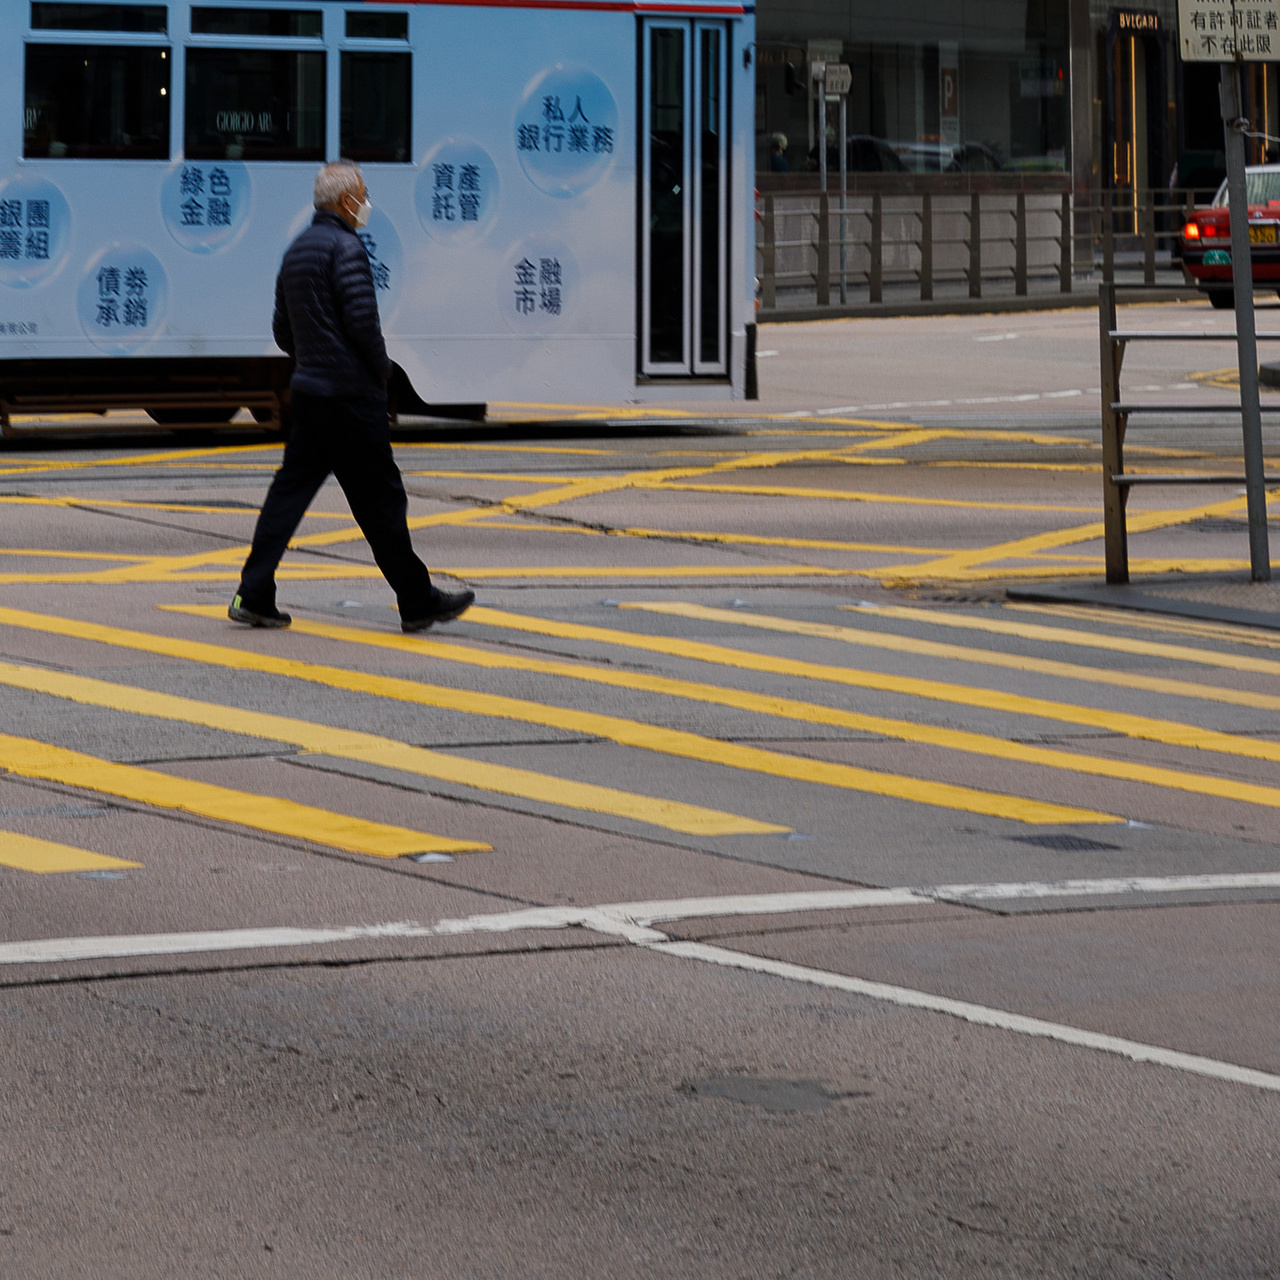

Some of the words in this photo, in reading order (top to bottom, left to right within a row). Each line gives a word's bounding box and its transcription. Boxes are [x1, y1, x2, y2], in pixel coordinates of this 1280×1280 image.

[1120, 13, 1158, 30] BVLGARI
[1190, 10, 1278, 30] 有許可証者
[1200, 34, 1271, 54] 不在此限
[543, 95, 589, 124] 私人
[517, 124, 614, 153] 銀行業務
[180, 197, 231, 226] 金融
[515, 257, 561, 286] 金融
[515, 286, 561, 315] 市場
